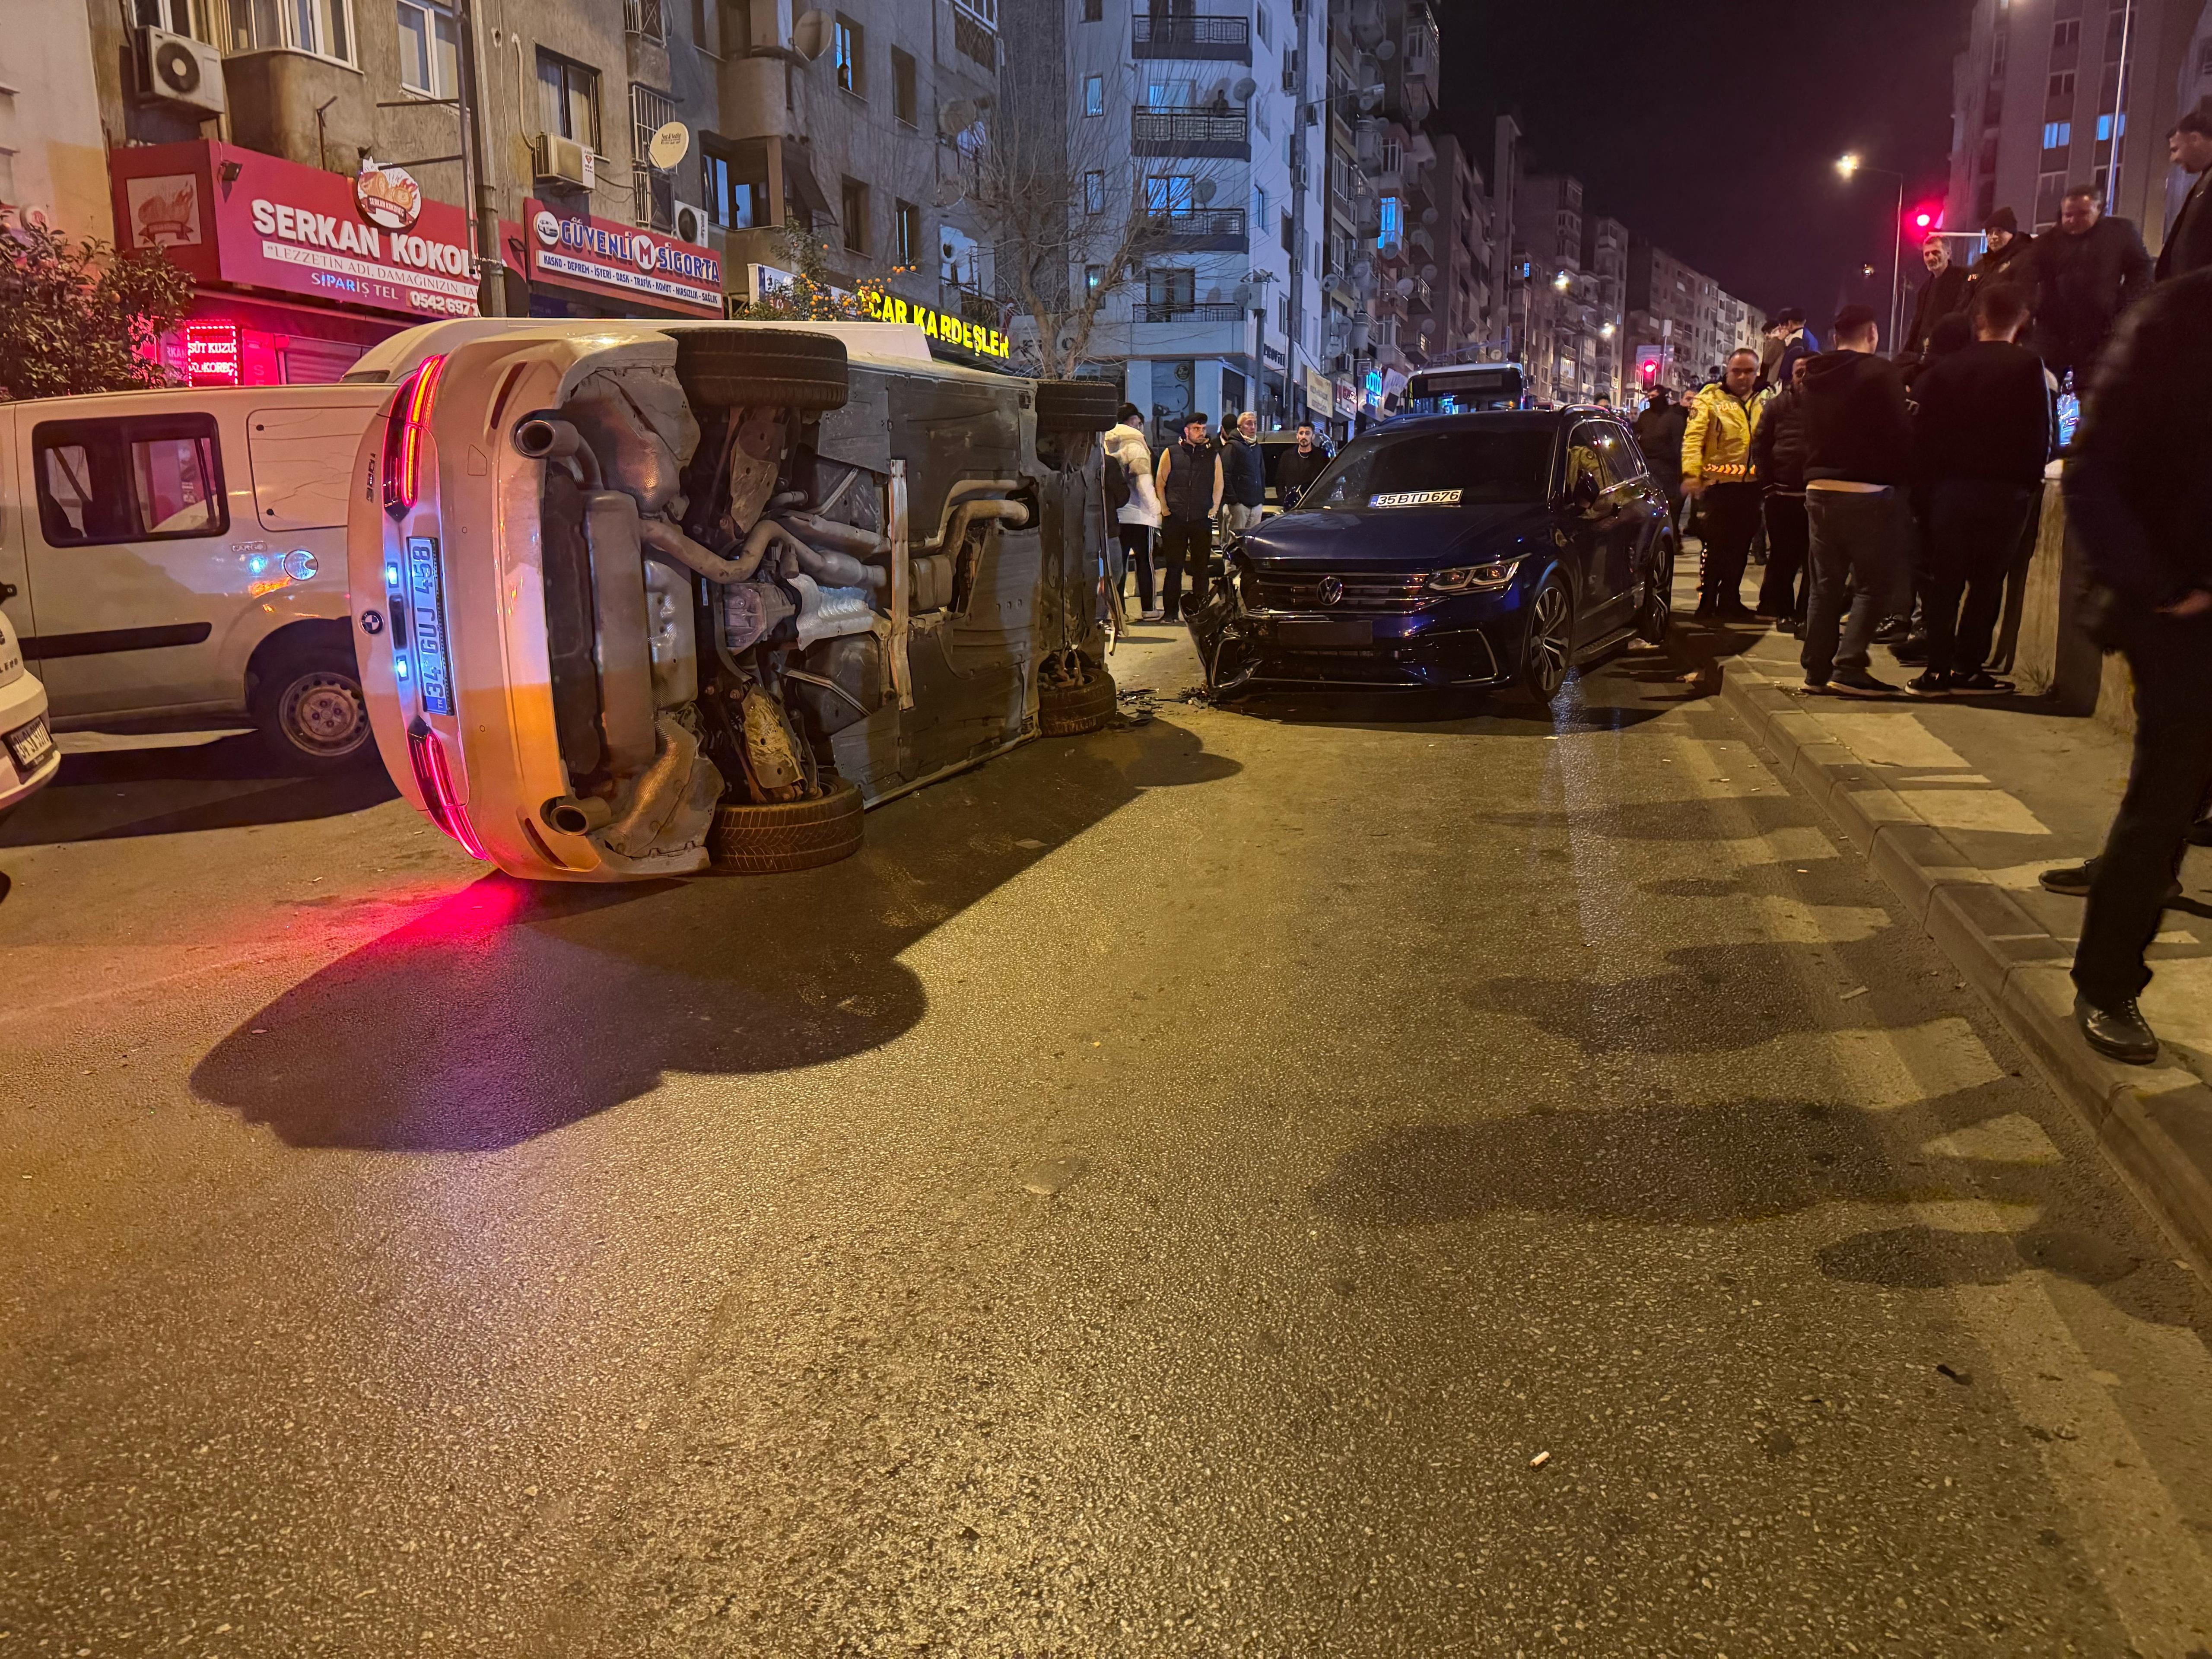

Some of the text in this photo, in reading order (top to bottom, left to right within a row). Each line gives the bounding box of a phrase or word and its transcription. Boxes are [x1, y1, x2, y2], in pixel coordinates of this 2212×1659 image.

[369, 197, 386, 208] SERKAN
[251, 199, 481, 280] SERKAN KOKO
[561, 217, 721, 283] GÜVENLİ M SİGORTA
[311, 272, 399, 300] SİPARİŞ TEL
[377, 267, 458, 294] DAMAĞINIZIN
[463, 286, 477, 298] TA
[544, 254, 718, 304] KASKO DEPREM İŞYERİ DASK TRAFİK KONUT HIRSIZLIK SAĞLIK
[410, 291, 482, 318] 0542 6971
[913, 305, 1010, 359] KARDEŞLER
[188, 341, 234, 354] SÜT KUZU
[1378, 491, 1459, 505] 35 BTD 676
[412, 546, 445, 698] 34 GUJ 458
[437, 699, 444, 709] TR
